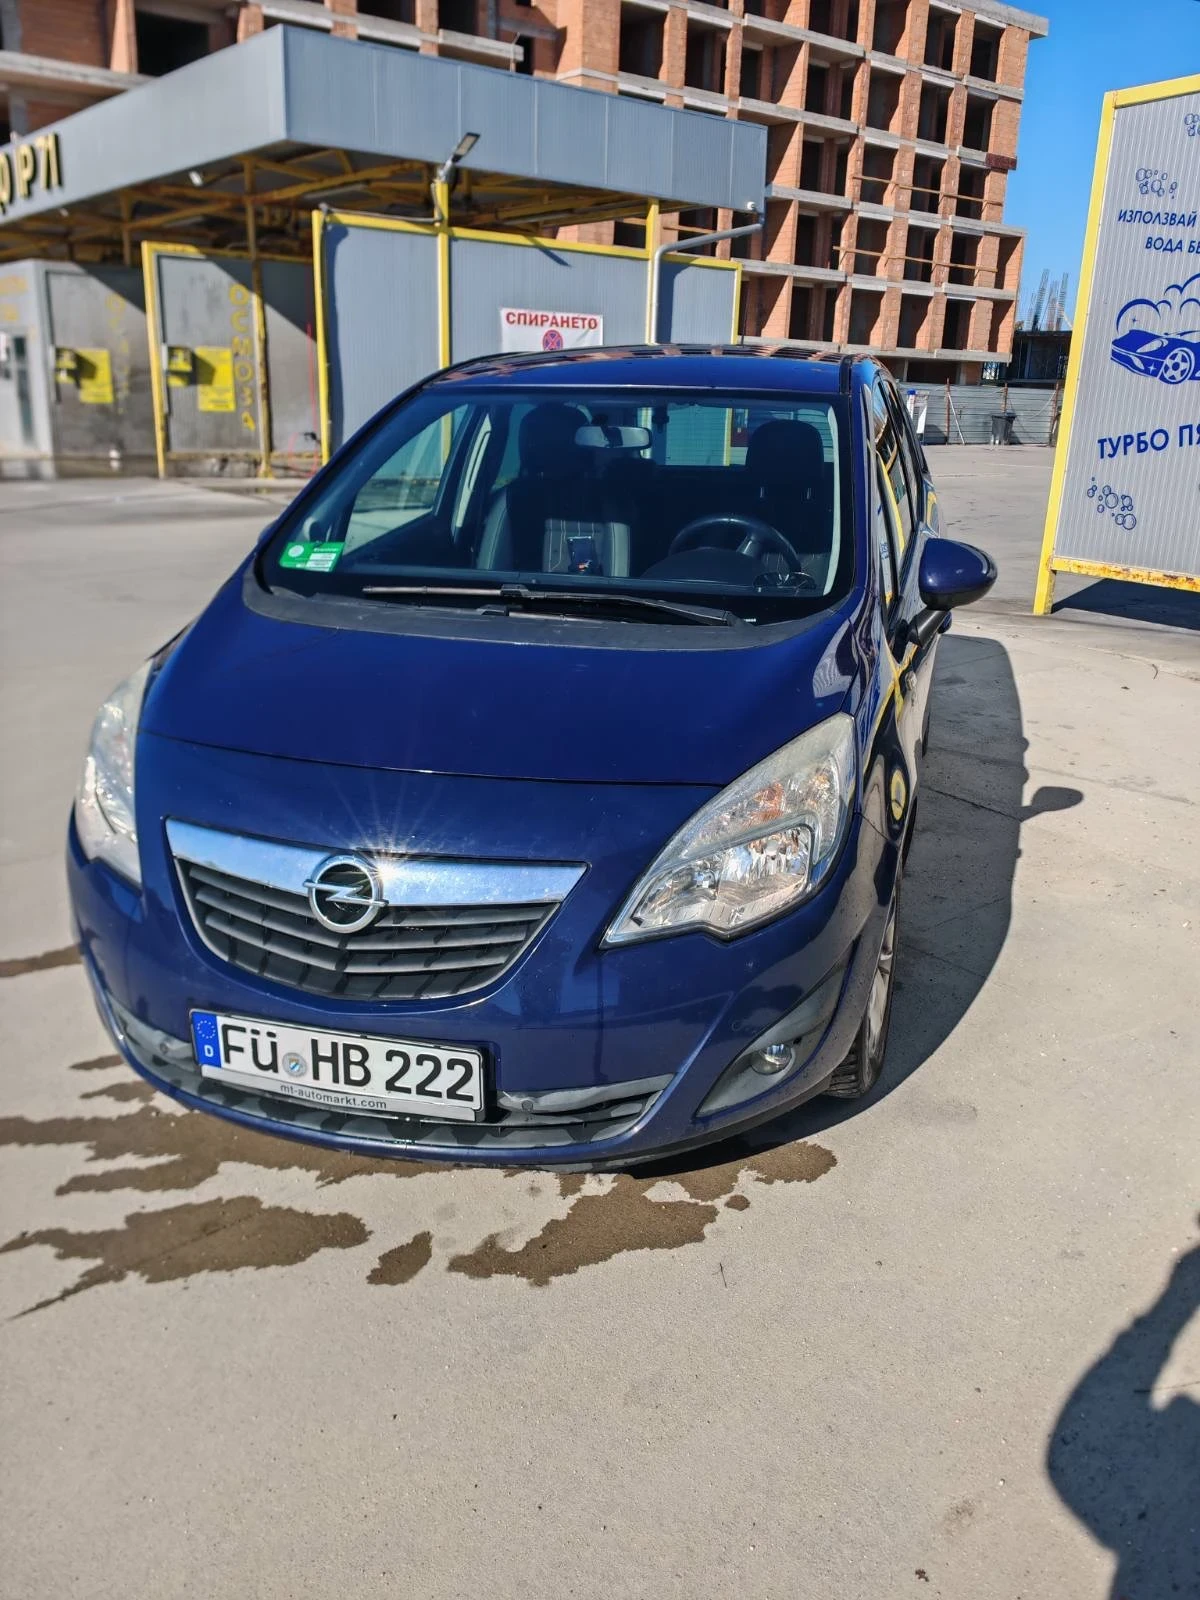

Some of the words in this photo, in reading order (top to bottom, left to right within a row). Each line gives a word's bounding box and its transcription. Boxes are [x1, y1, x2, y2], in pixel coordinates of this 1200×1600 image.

[1118, 208, 1198, 228] ИЗПОЛЗВАЙ
[1145, 236, 1183, 253] ВОДА
[505, 311, 598, 330] СПИРАНЕТО
[1098, 428, 1170, 459] ТУРБО
[204, 1044, 215, 1057] D
[310, 1038, 372, 1088] HB
[385, 1049, 475, 1102] 222
[280, 1083, 387, 1109] mt-automarkt.com
